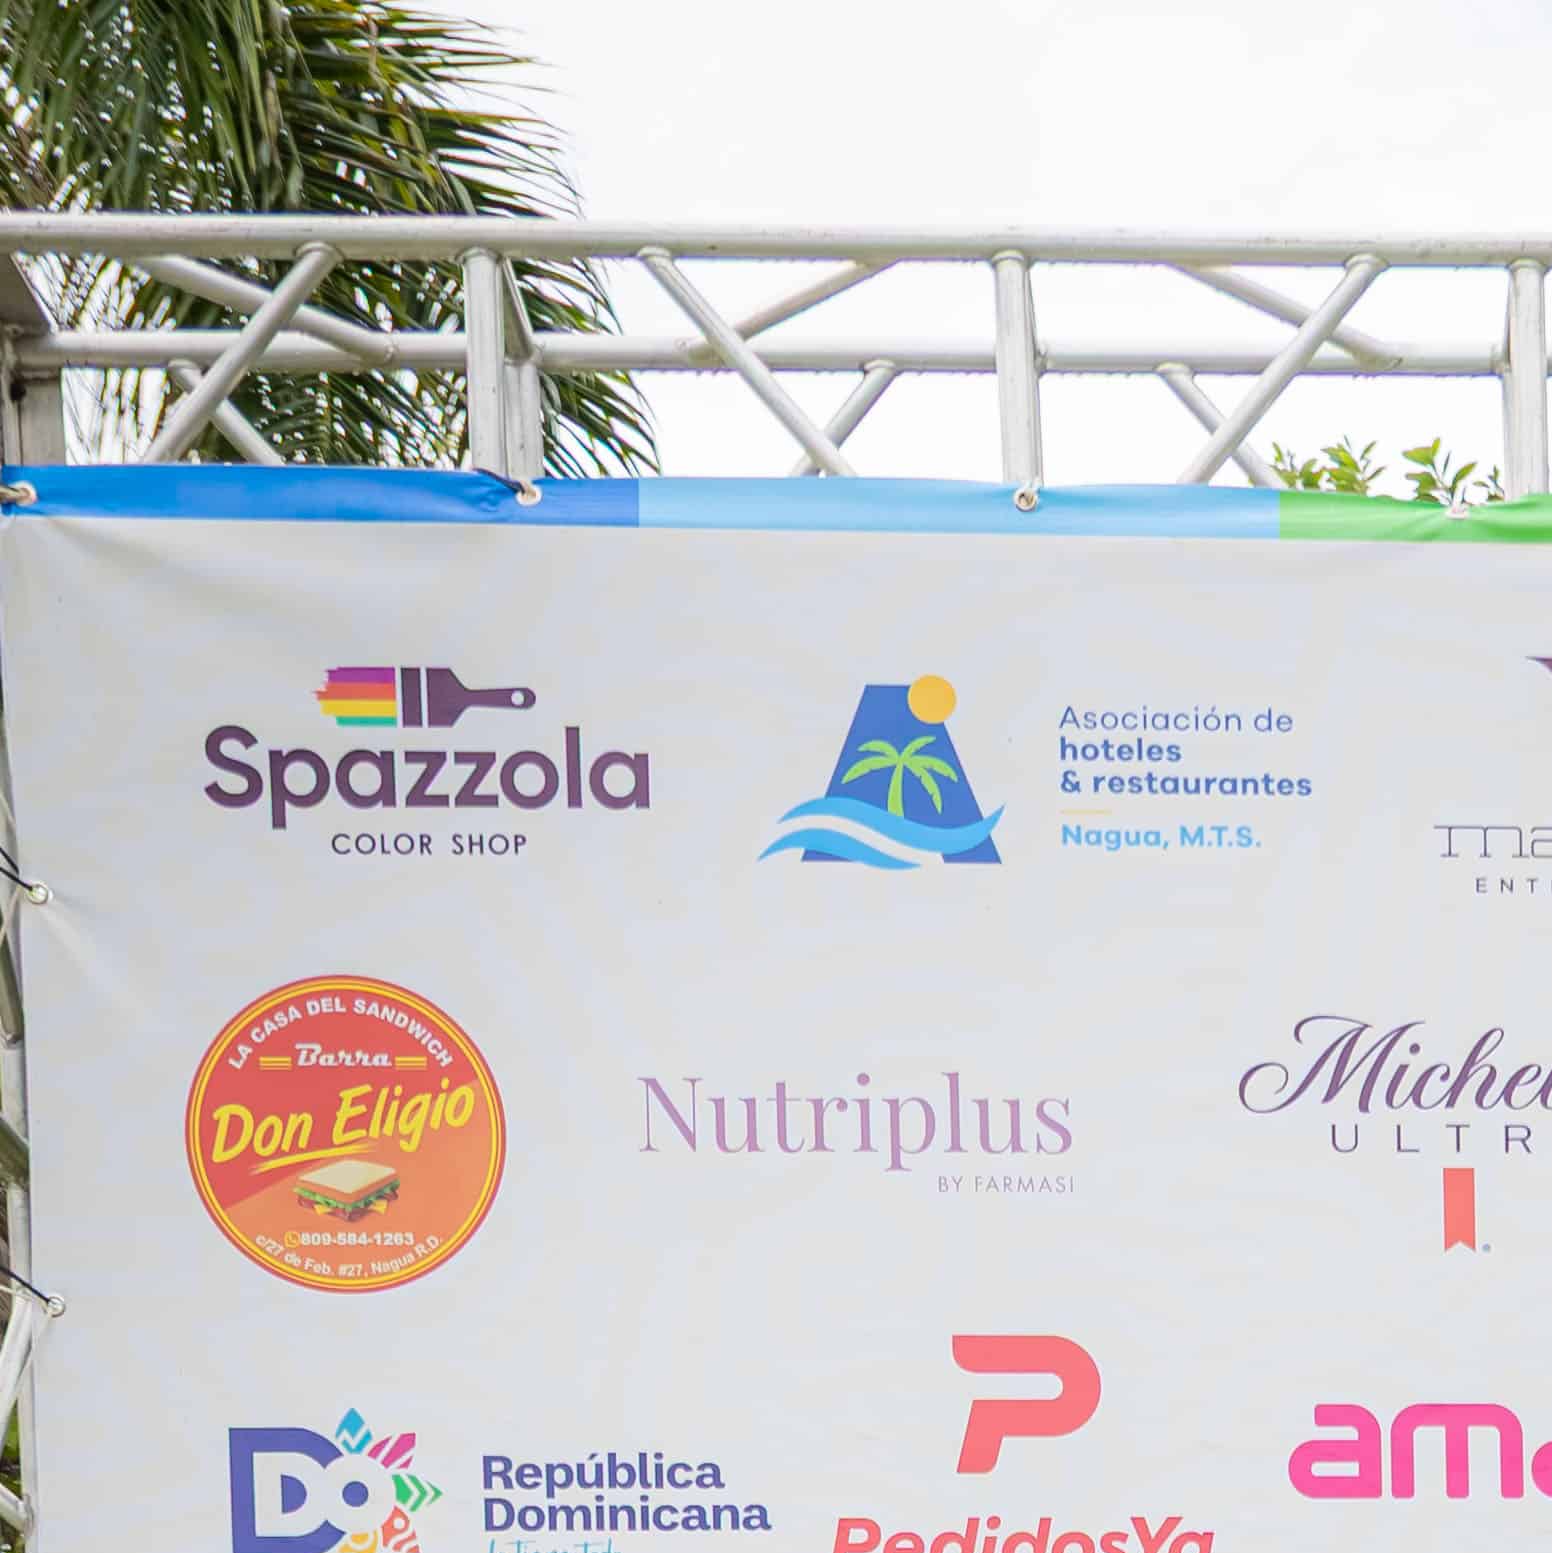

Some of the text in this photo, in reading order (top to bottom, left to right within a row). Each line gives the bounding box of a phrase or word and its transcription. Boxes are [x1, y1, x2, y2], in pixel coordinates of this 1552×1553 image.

[1058, 705, 1294, 733] Asociación de
[1059, 735, 1183, 762] hoteles
[204, 724, 651, 830] Spazzola
[1091, 771, 1313, 798] restaurantes
[331, 833, 528, 856] COLOR SHOP
[1061, 824, 1262, 853] Nagua, M.T.S.
[227, 995, 455, 1071] LA CASA DEL SANDWICH
[293, 1042, 394, 1068] Barra
[210, 1075, 476, 1164] Don Eligio
[638, 1070, 1074, 1172] Nutriplus
[937, 1175, 1076, 1194] BY FARMASI
[370, 1251, 416, 1277] Nagua
[482, 1451, 726, 1499] República
[484, 1495, 772, 1532] Dominicana
